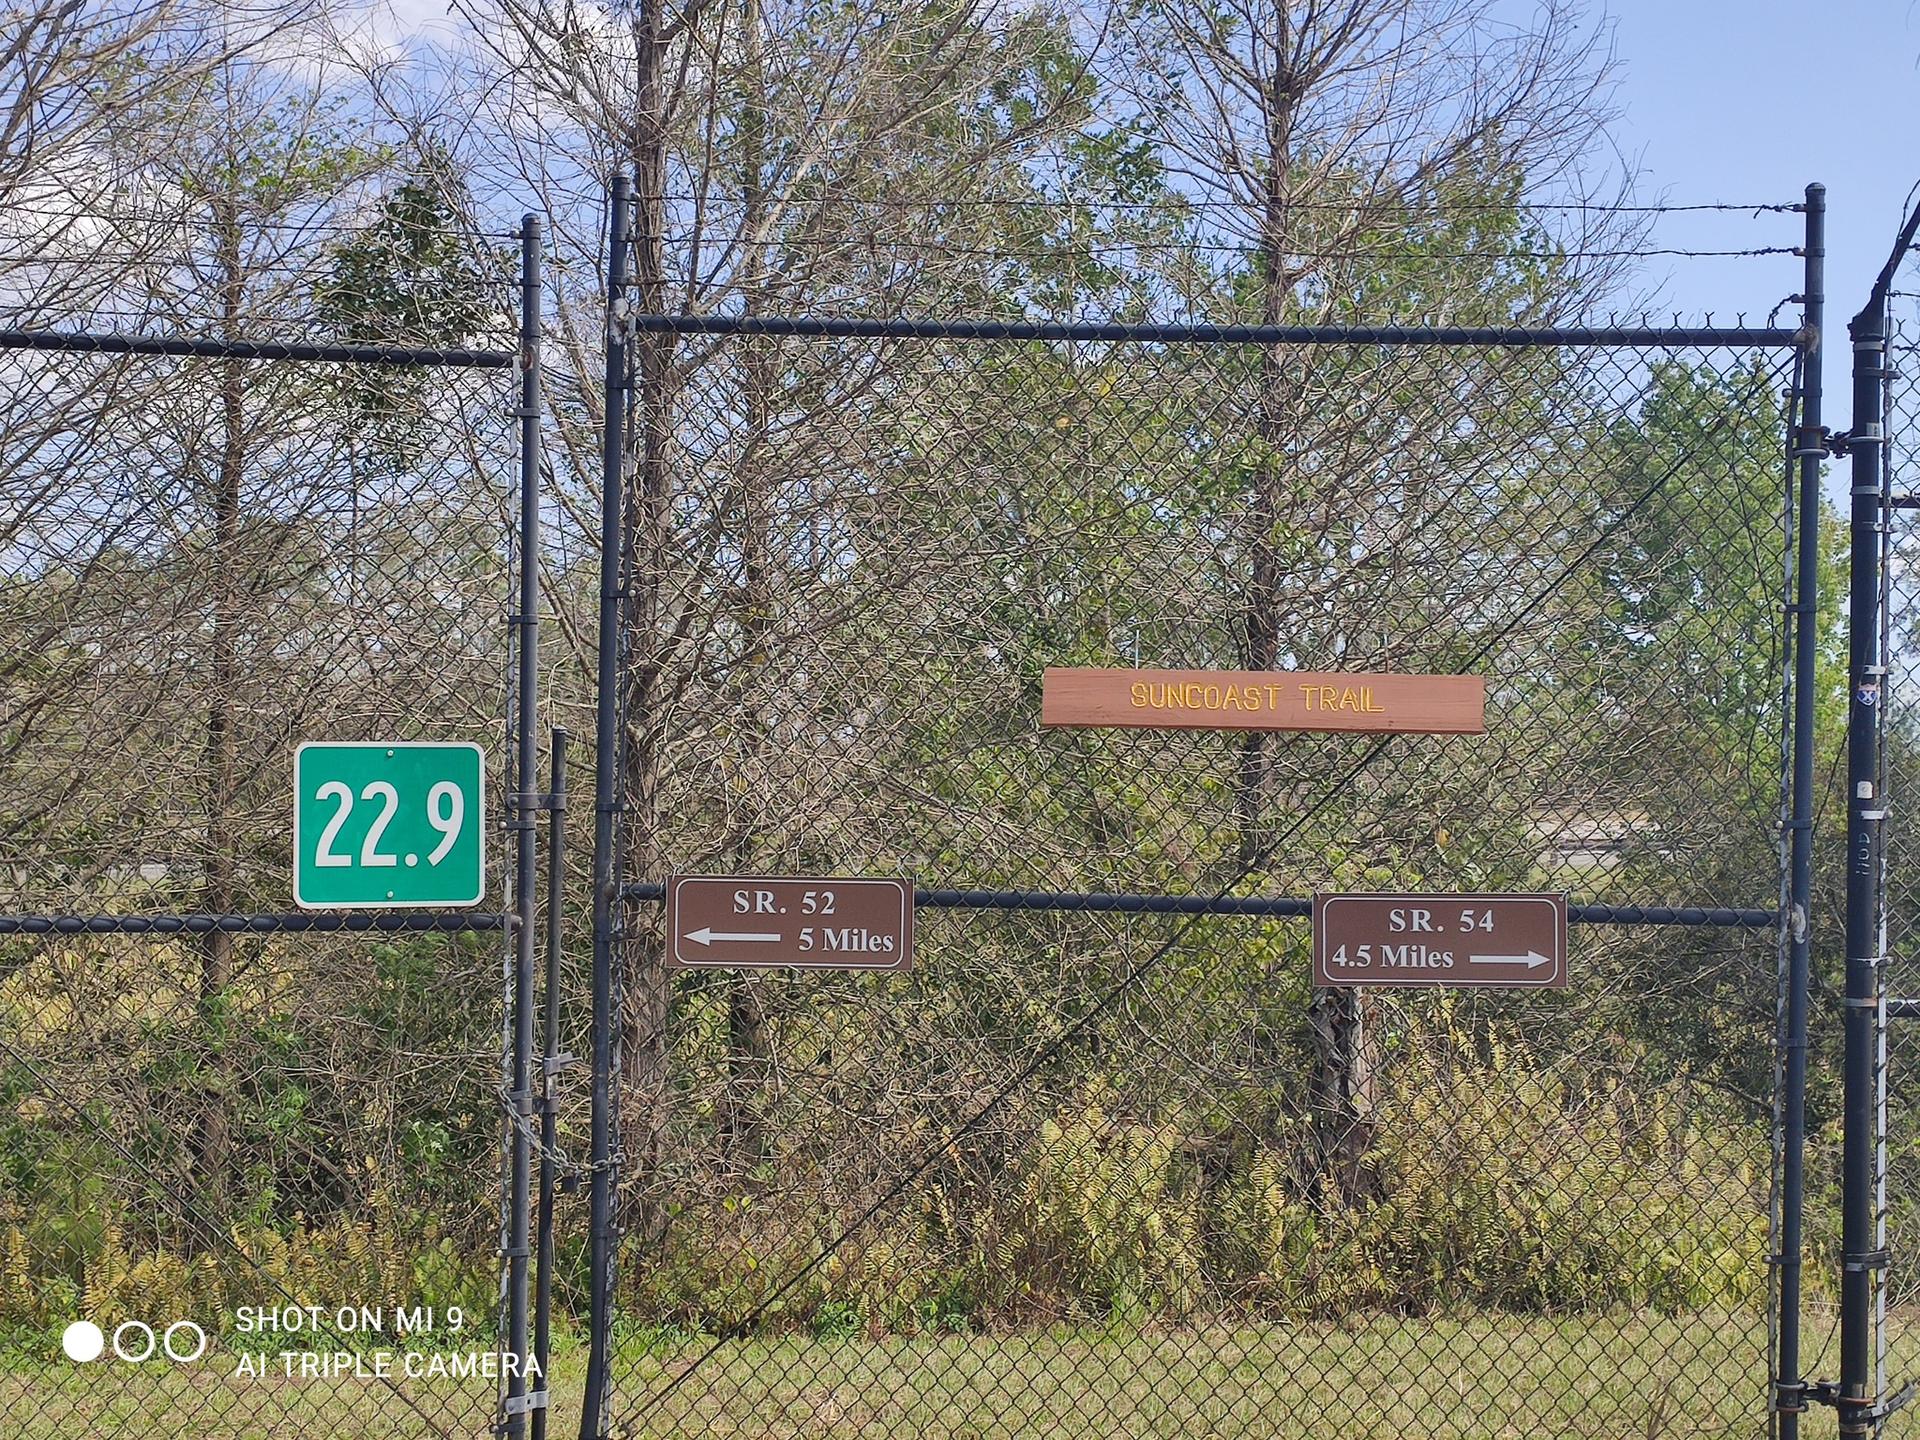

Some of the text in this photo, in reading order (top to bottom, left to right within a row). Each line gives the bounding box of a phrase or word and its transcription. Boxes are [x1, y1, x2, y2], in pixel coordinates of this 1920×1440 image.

[1130, 681, 1385, 713] SUNCOAST TRAIL
[314, 780, 465, 868] 22.9
[732, 890, 836, 915] SR. 52
[1389, 909, 1495, 933] SR. 54
[798, 927, 894, 952] 5 Miles
[1332, 944, 1454, 969] 4.5 Miles
